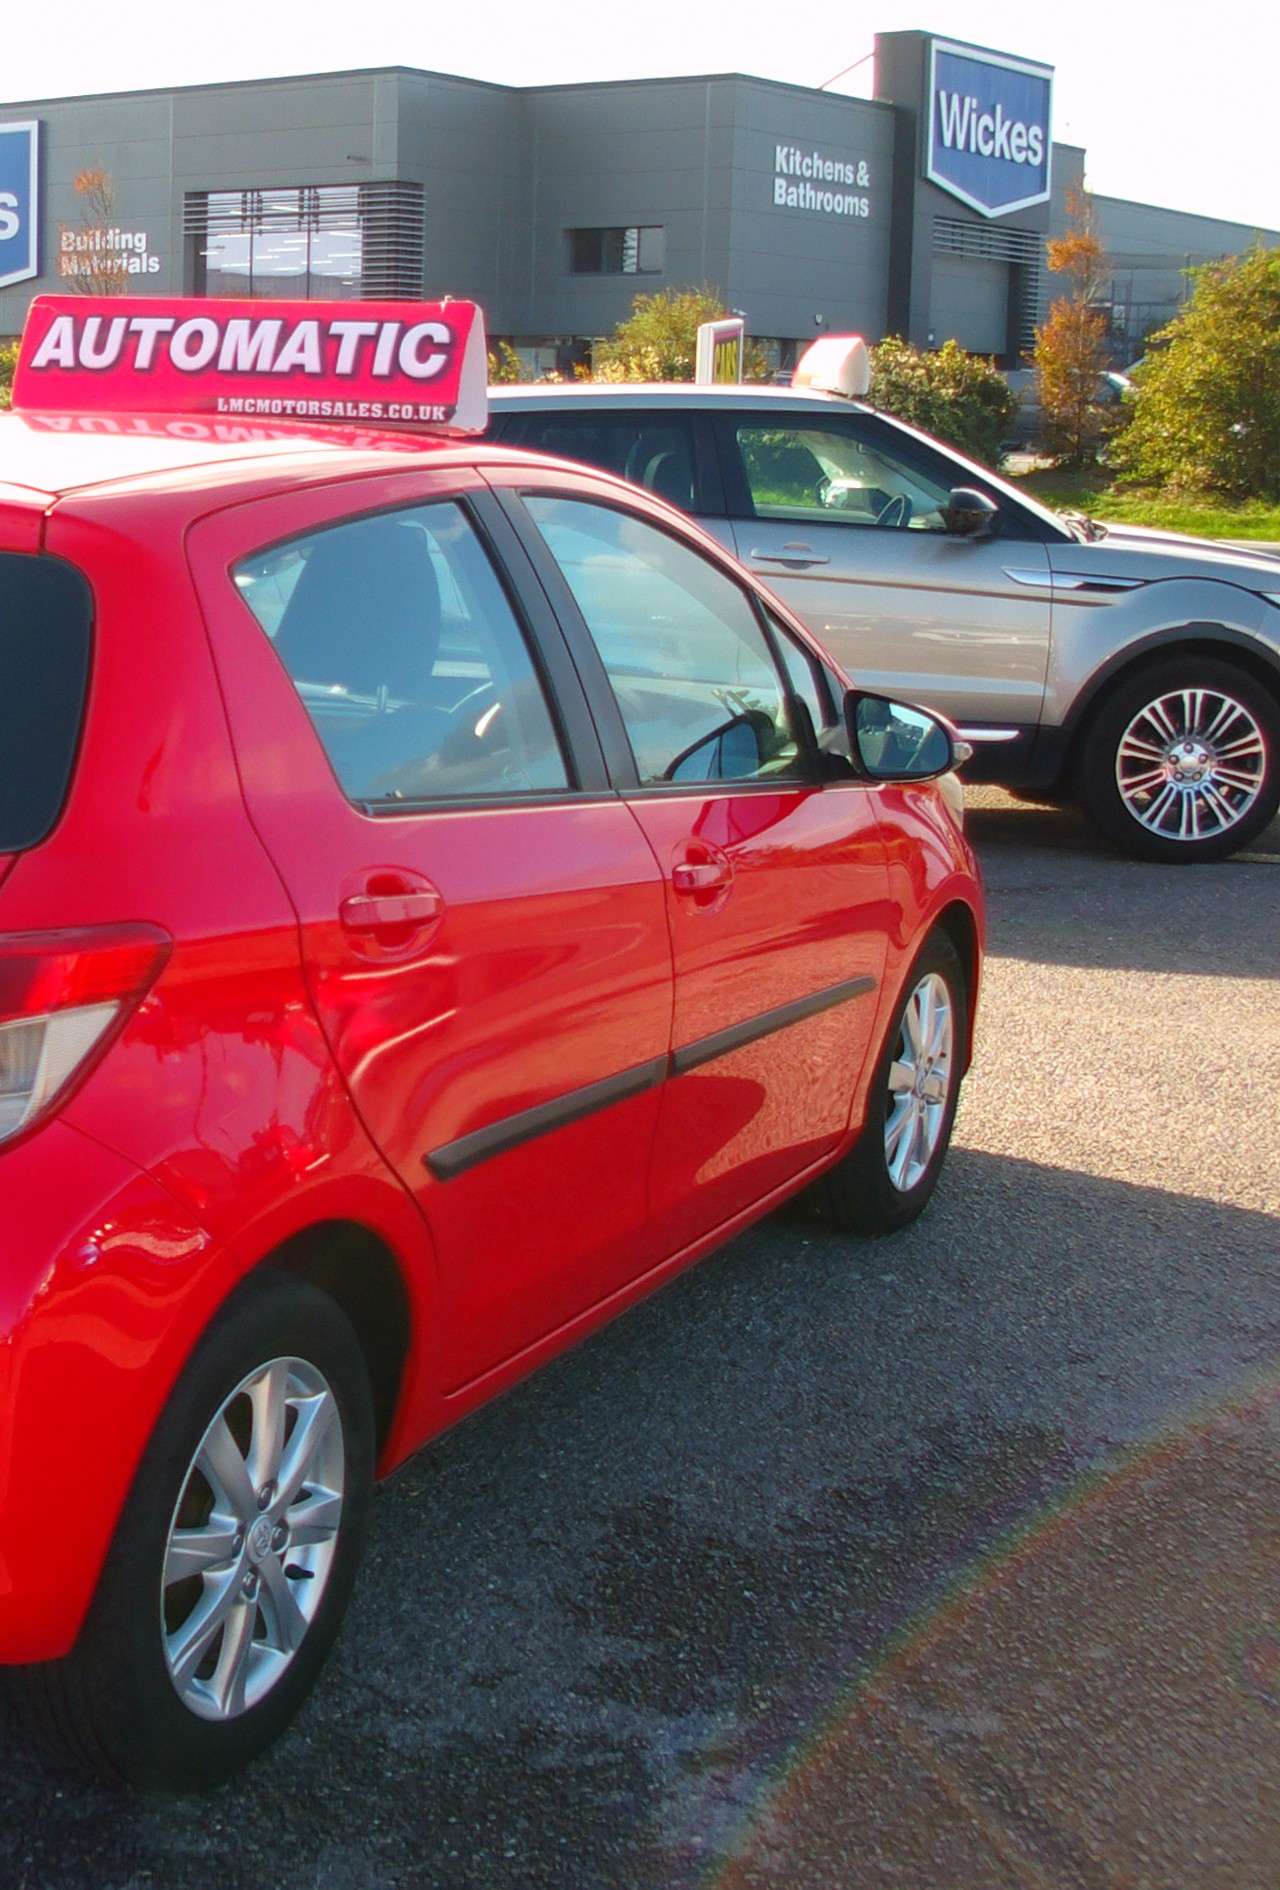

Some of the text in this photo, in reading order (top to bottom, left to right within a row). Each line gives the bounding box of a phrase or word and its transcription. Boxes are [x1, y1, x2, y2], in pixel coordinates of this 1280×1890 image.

[940, 90, 1043, 167] Wickes
[775, 145, 870, 188] Kitchens &
[774, 178, 869, 218] Bathrooms
[61, 228, 147, 253] Building
[30, 315, 452, 378] AUTOMATIC
[217, 397, 446, 421] LMCMOTORSALES.CO.UK
